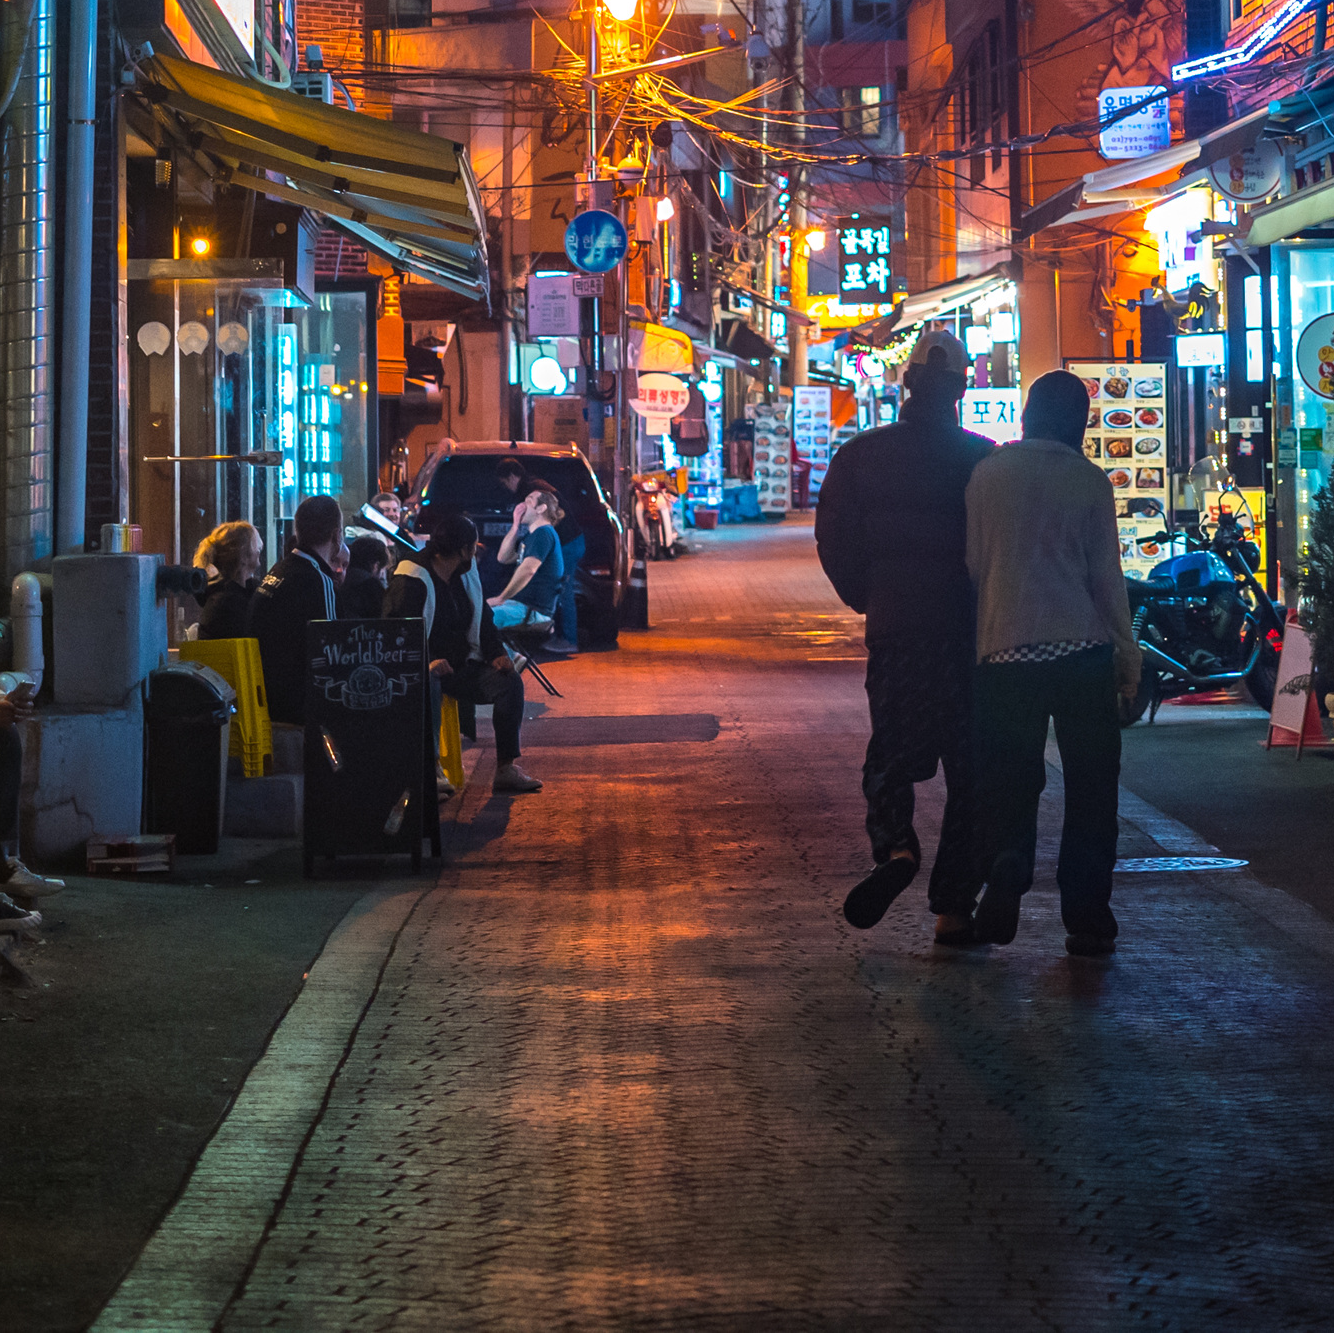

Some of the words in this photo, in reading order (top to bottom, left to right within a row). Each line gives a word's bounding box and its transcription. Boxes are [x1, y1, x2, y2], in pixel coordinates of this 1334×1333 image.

[840, 226, 891, 255] 골목길
[840, 257, 891, 294] 포차
[972, 400, 1016, 424] 포차
[350, 623, 376, 641] The
